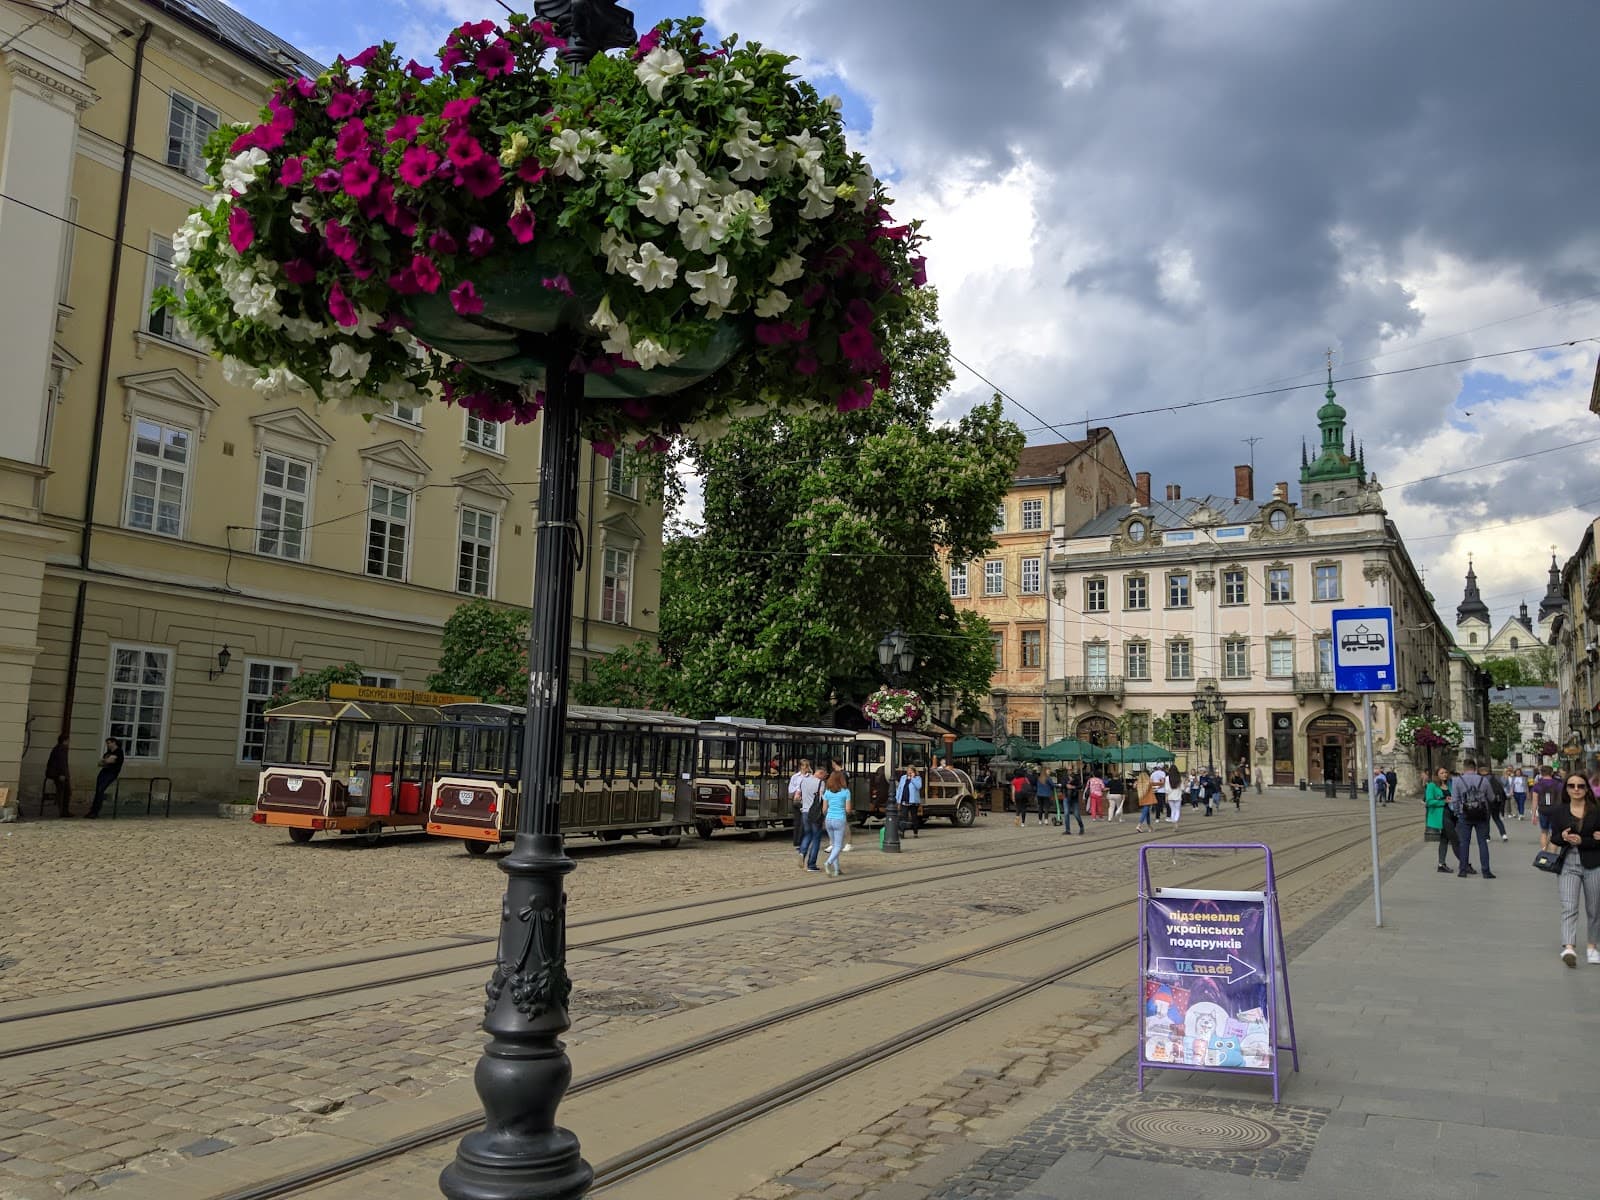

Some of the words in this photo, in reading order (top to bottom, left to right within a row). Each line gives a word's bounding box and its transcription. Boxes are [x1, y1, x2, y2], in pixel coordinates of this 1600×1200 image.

[1169, 910, 1240, 923] підземелля
[1166, 923, 1244, 936] українських
[1169, 937, 1242, 951] подарунків
